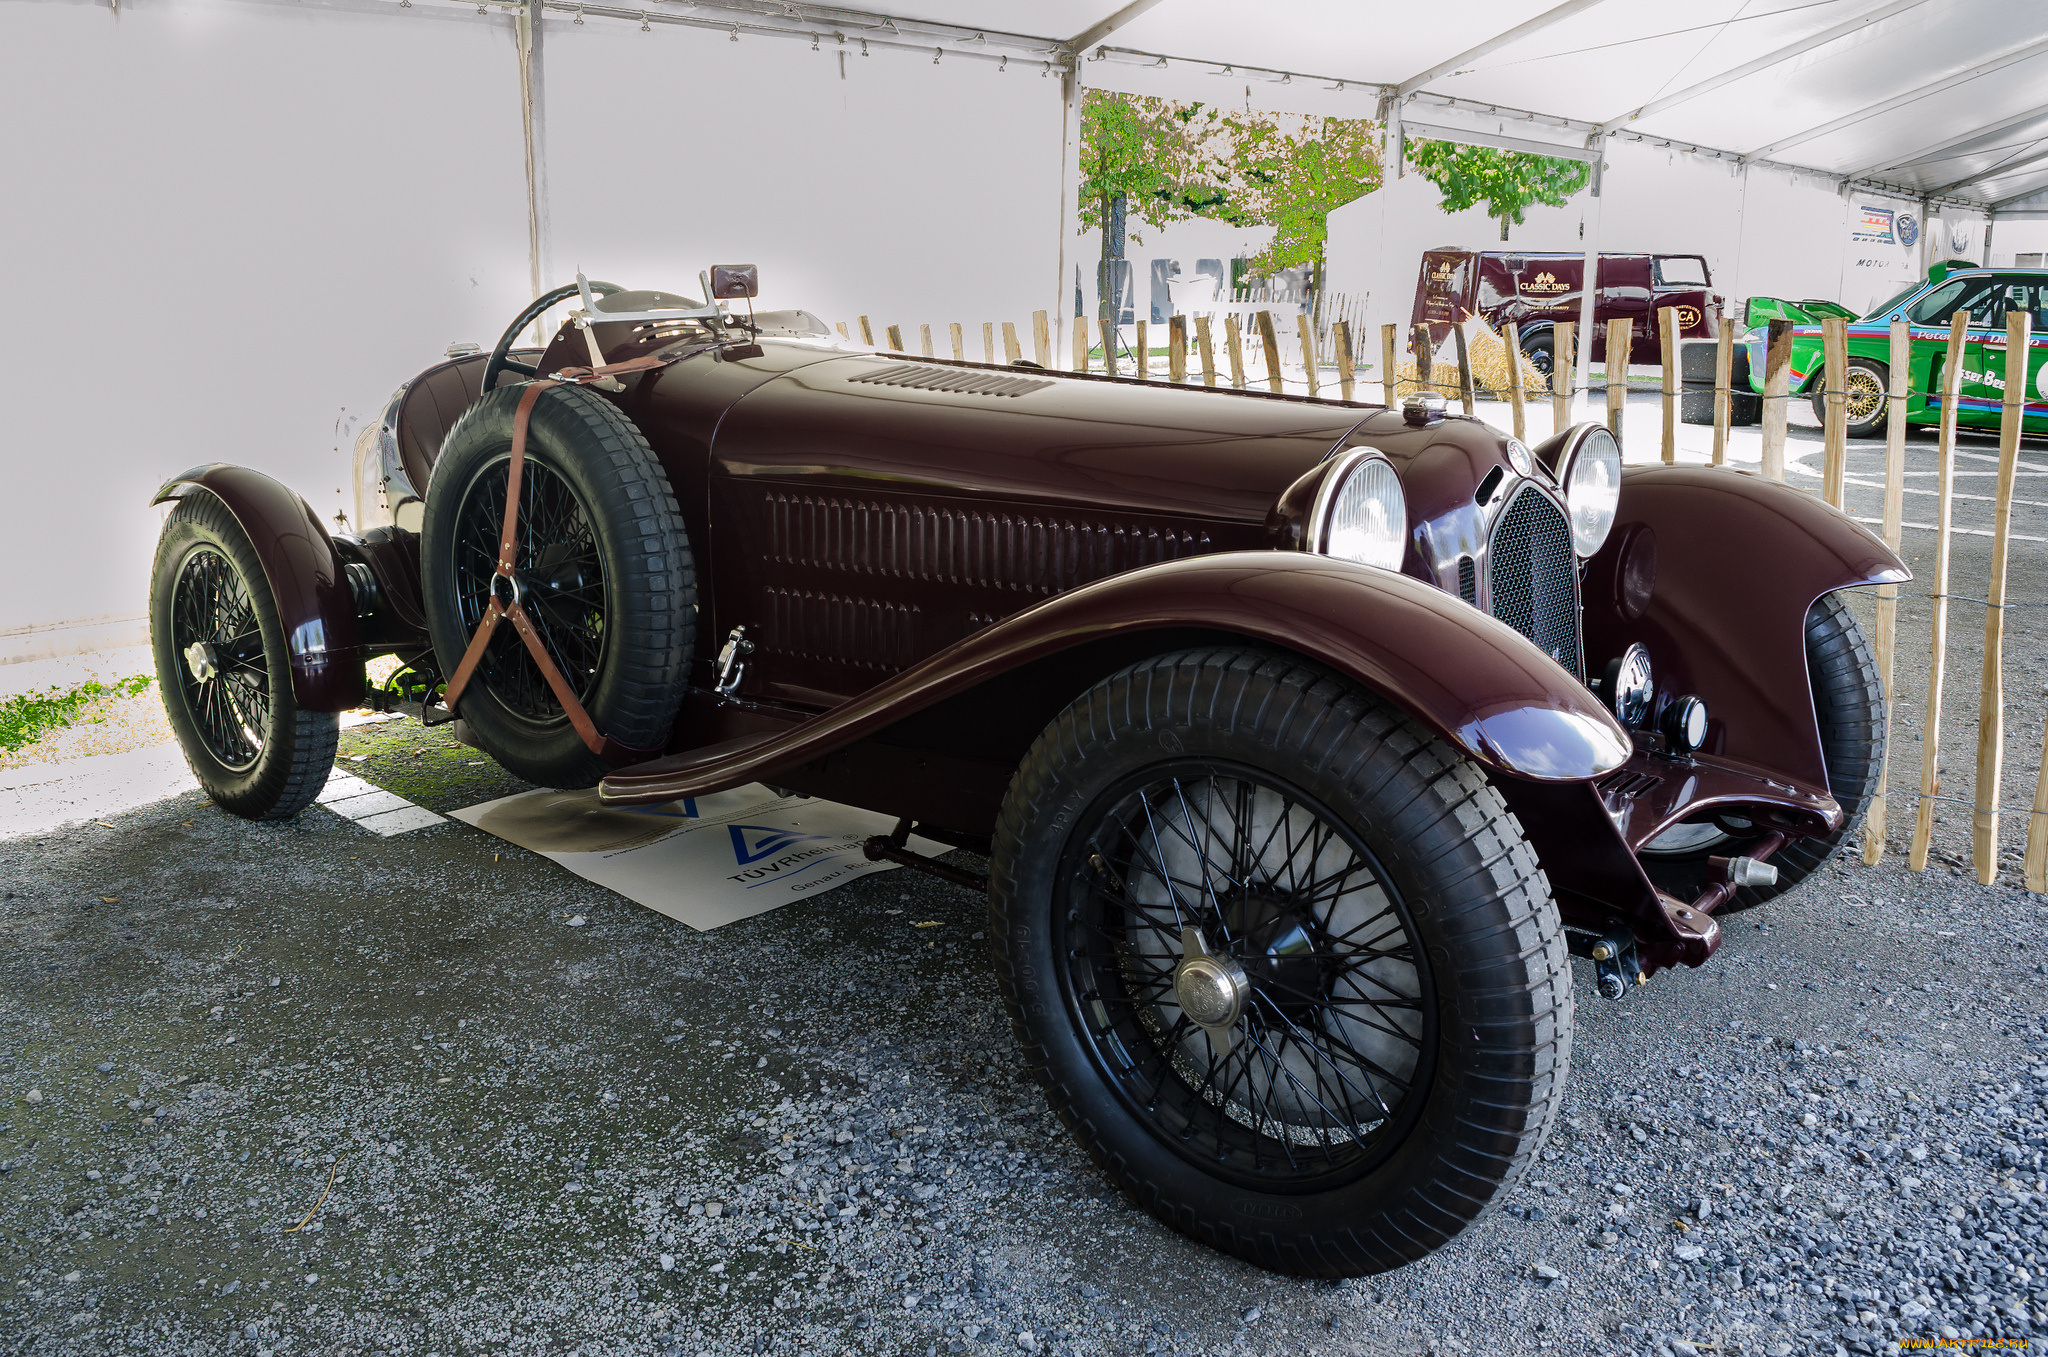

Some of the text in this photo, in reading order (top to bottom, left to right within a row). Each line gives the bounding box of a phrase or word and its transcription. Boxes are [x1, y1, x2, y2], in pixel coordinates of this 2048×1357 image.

[1520, 282, 1570, 291] CLASSIC DAYS
[1678, 310, 1695, 322] CA
[1982, 369, 2006, 391] Bee
[791, 870, 846, 892] Genau.
